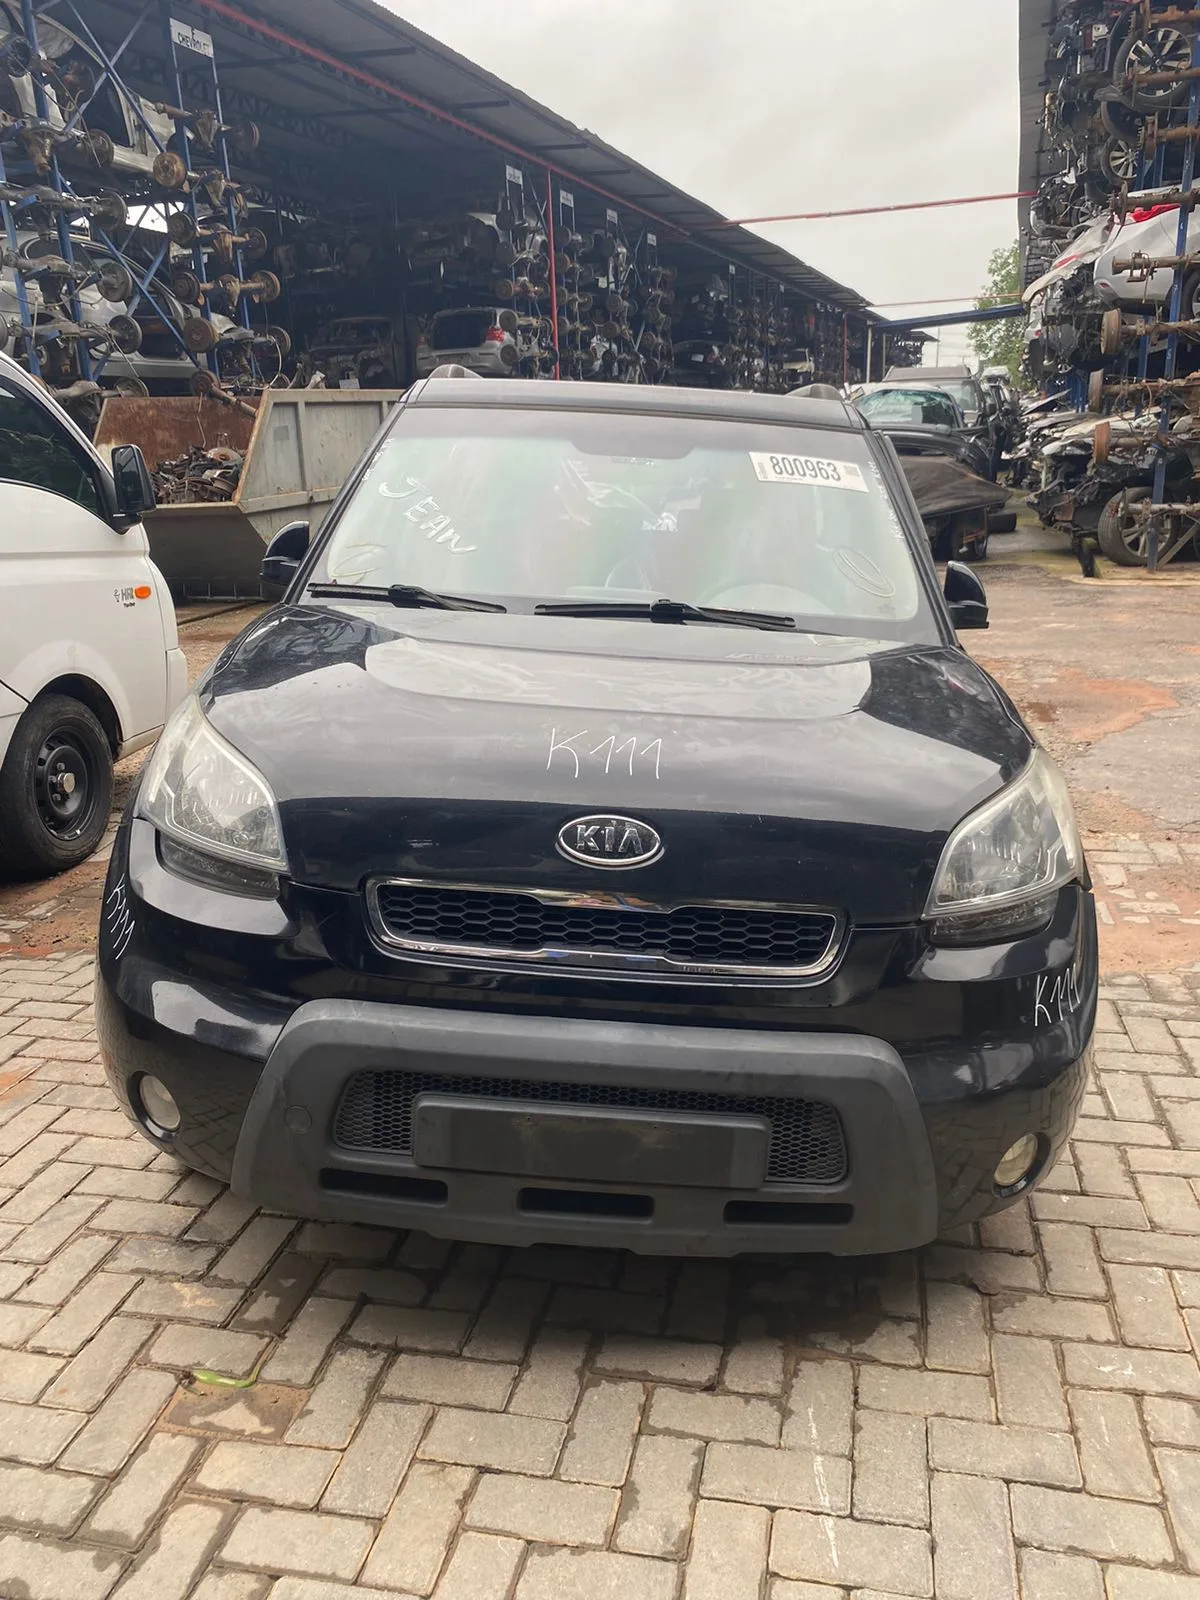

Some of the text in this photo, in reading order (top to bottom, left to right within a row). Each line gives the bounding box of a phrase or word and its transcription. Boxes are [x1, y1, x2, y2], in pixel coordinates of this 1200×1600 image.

[769, 455, 841, 482] 800963
[378, 476, 478, 556] JEAN
[546, 727, 662, 780] K111
[575, 824, 644, 855] KIA
